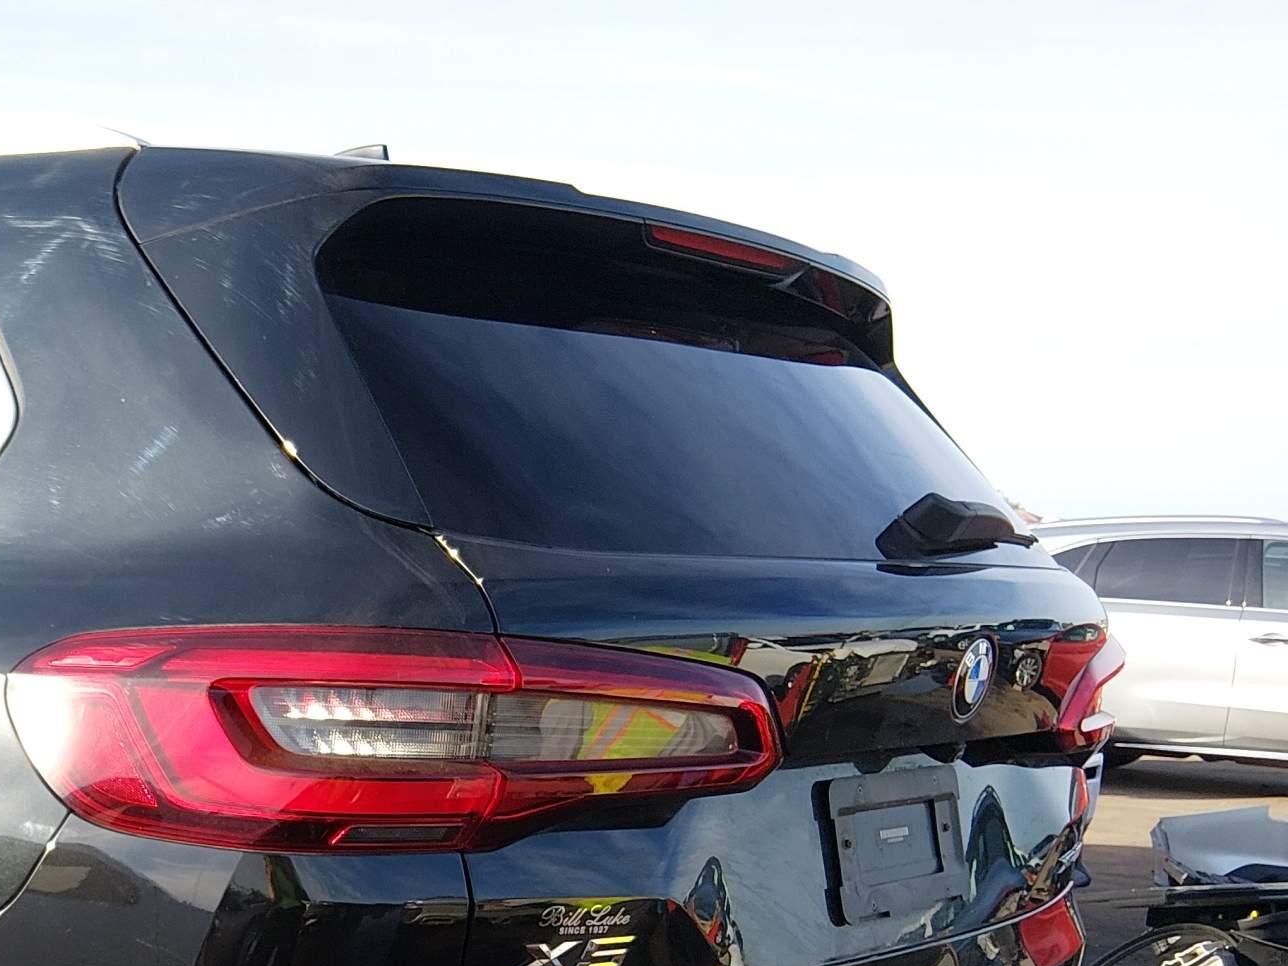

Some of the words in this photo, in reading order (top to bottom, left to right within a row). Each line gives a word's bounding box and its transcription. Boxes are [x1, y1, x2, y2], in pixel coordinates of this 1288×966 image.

[539, 906, 586, 926] Bill
[585, 904, 631, 925] Luke
[559, 926, 585, 935] SINCE
